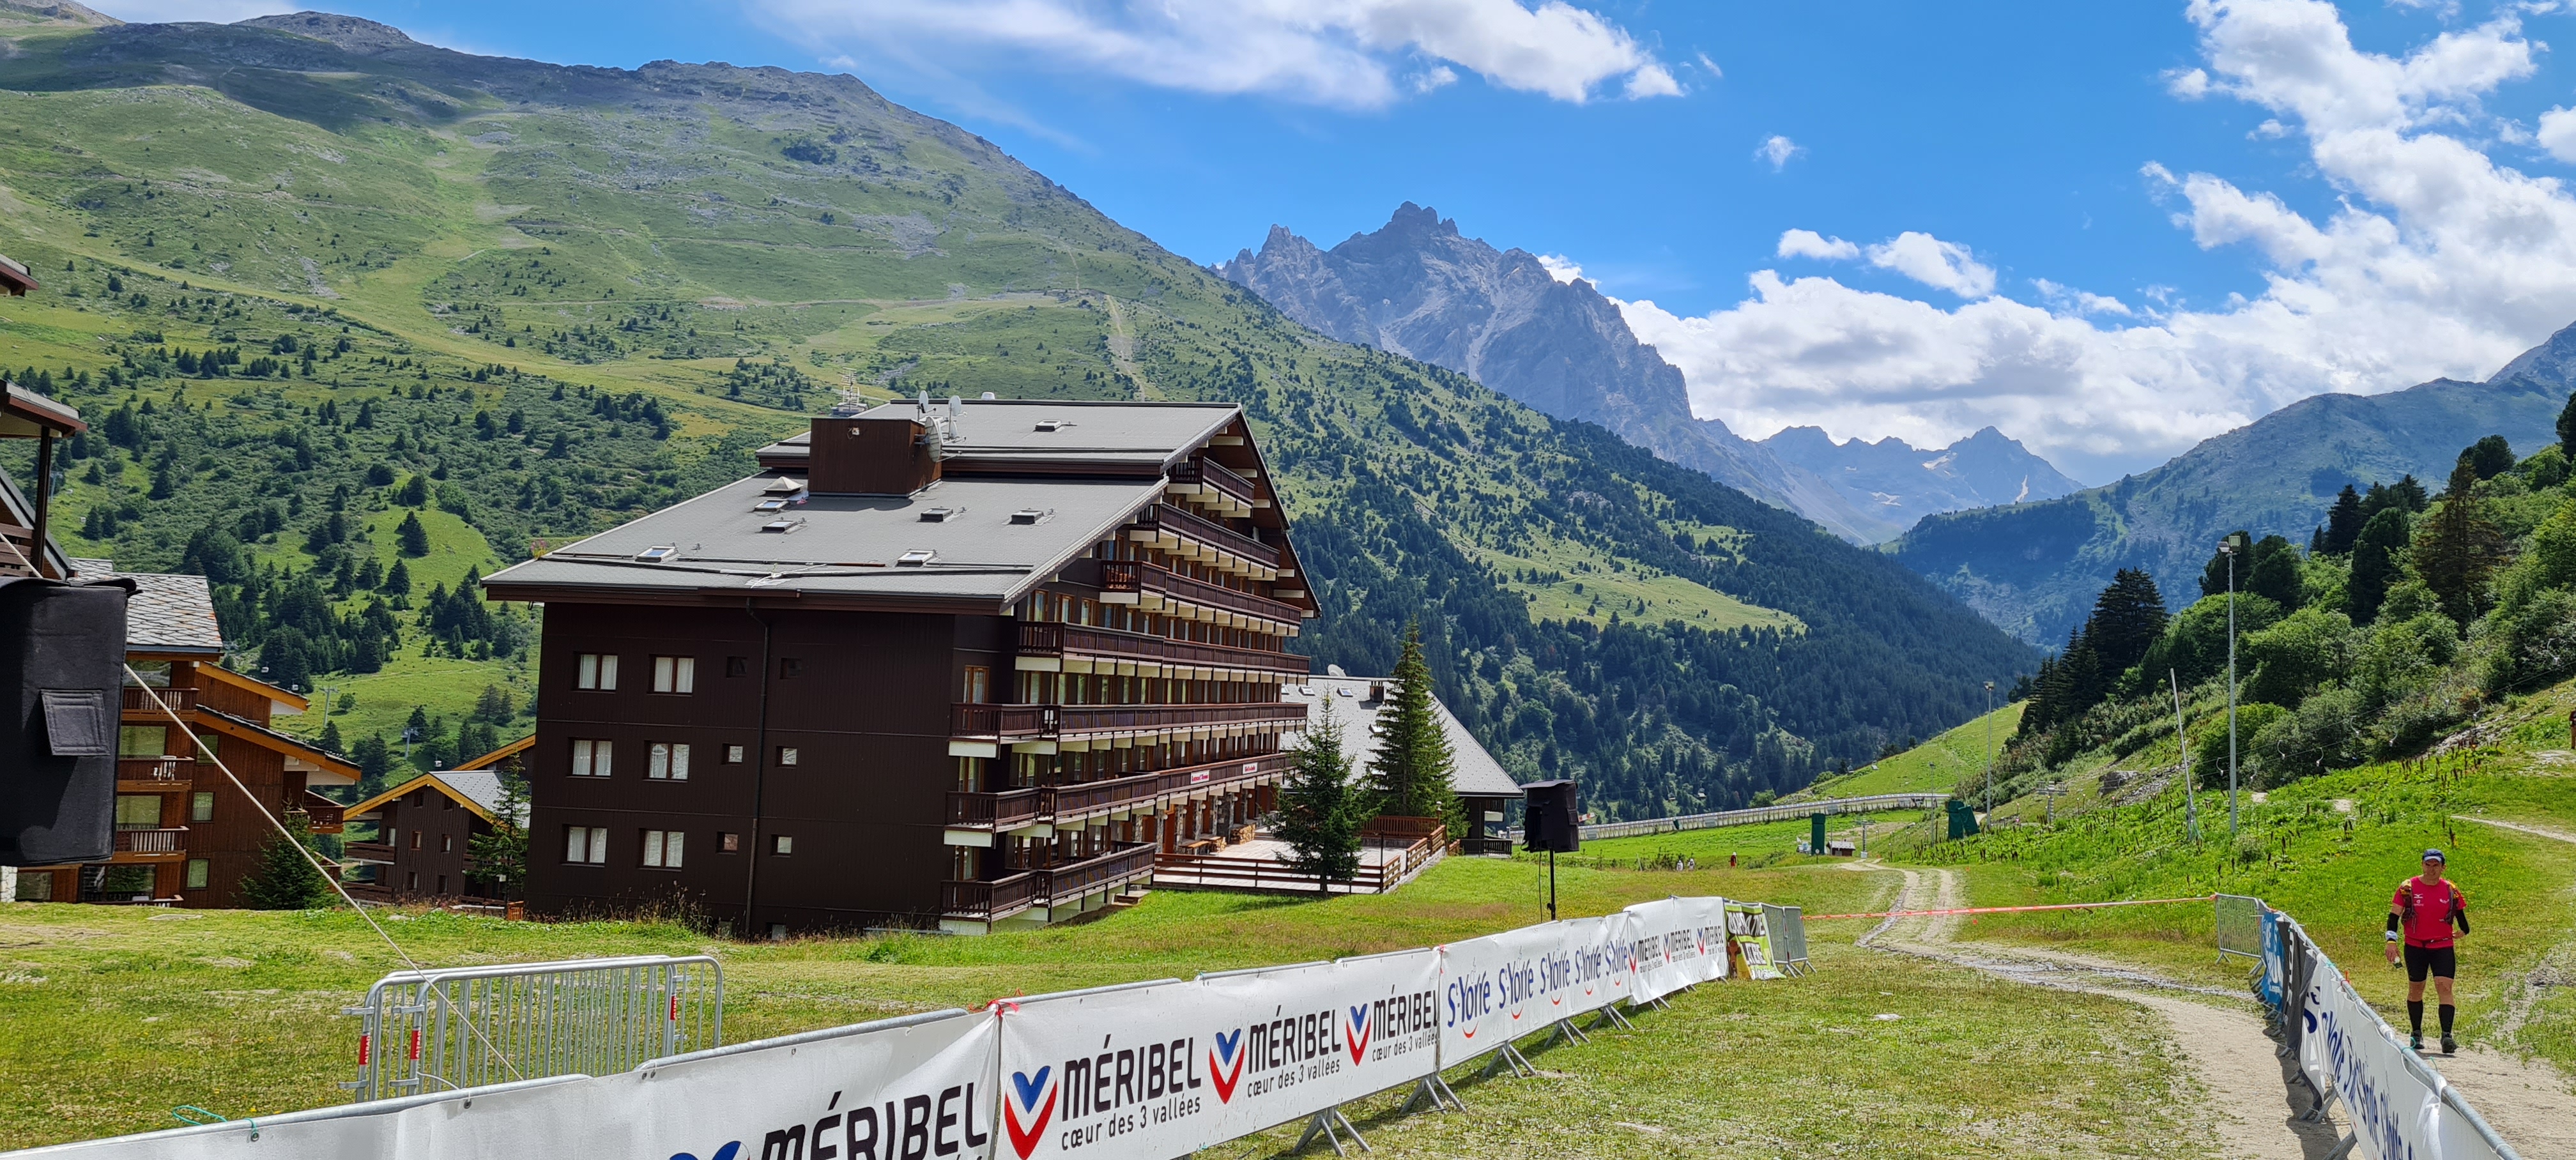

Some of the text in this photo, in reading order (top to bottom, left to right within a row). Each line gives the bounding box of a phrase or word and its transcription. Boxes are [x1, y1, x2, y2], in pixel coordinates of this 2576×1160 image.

[1671, 924, 1695, 953] MÉRIBEL
[1248, 1005, 1341, 1074] MÉRIBEL
[1372, 1045, 1392, 1062] cœur
[1394, 1039, 1406, 1056] des
[1408, 1035, 1413, 1052] 3
[1062, 1034, 1201, 1122] MÉRIBEL
[1247, 1055, 1340, 1098] cœur des 3 vallées
[1062, 1093, 1200, 1150] cœur des 3 vallées
